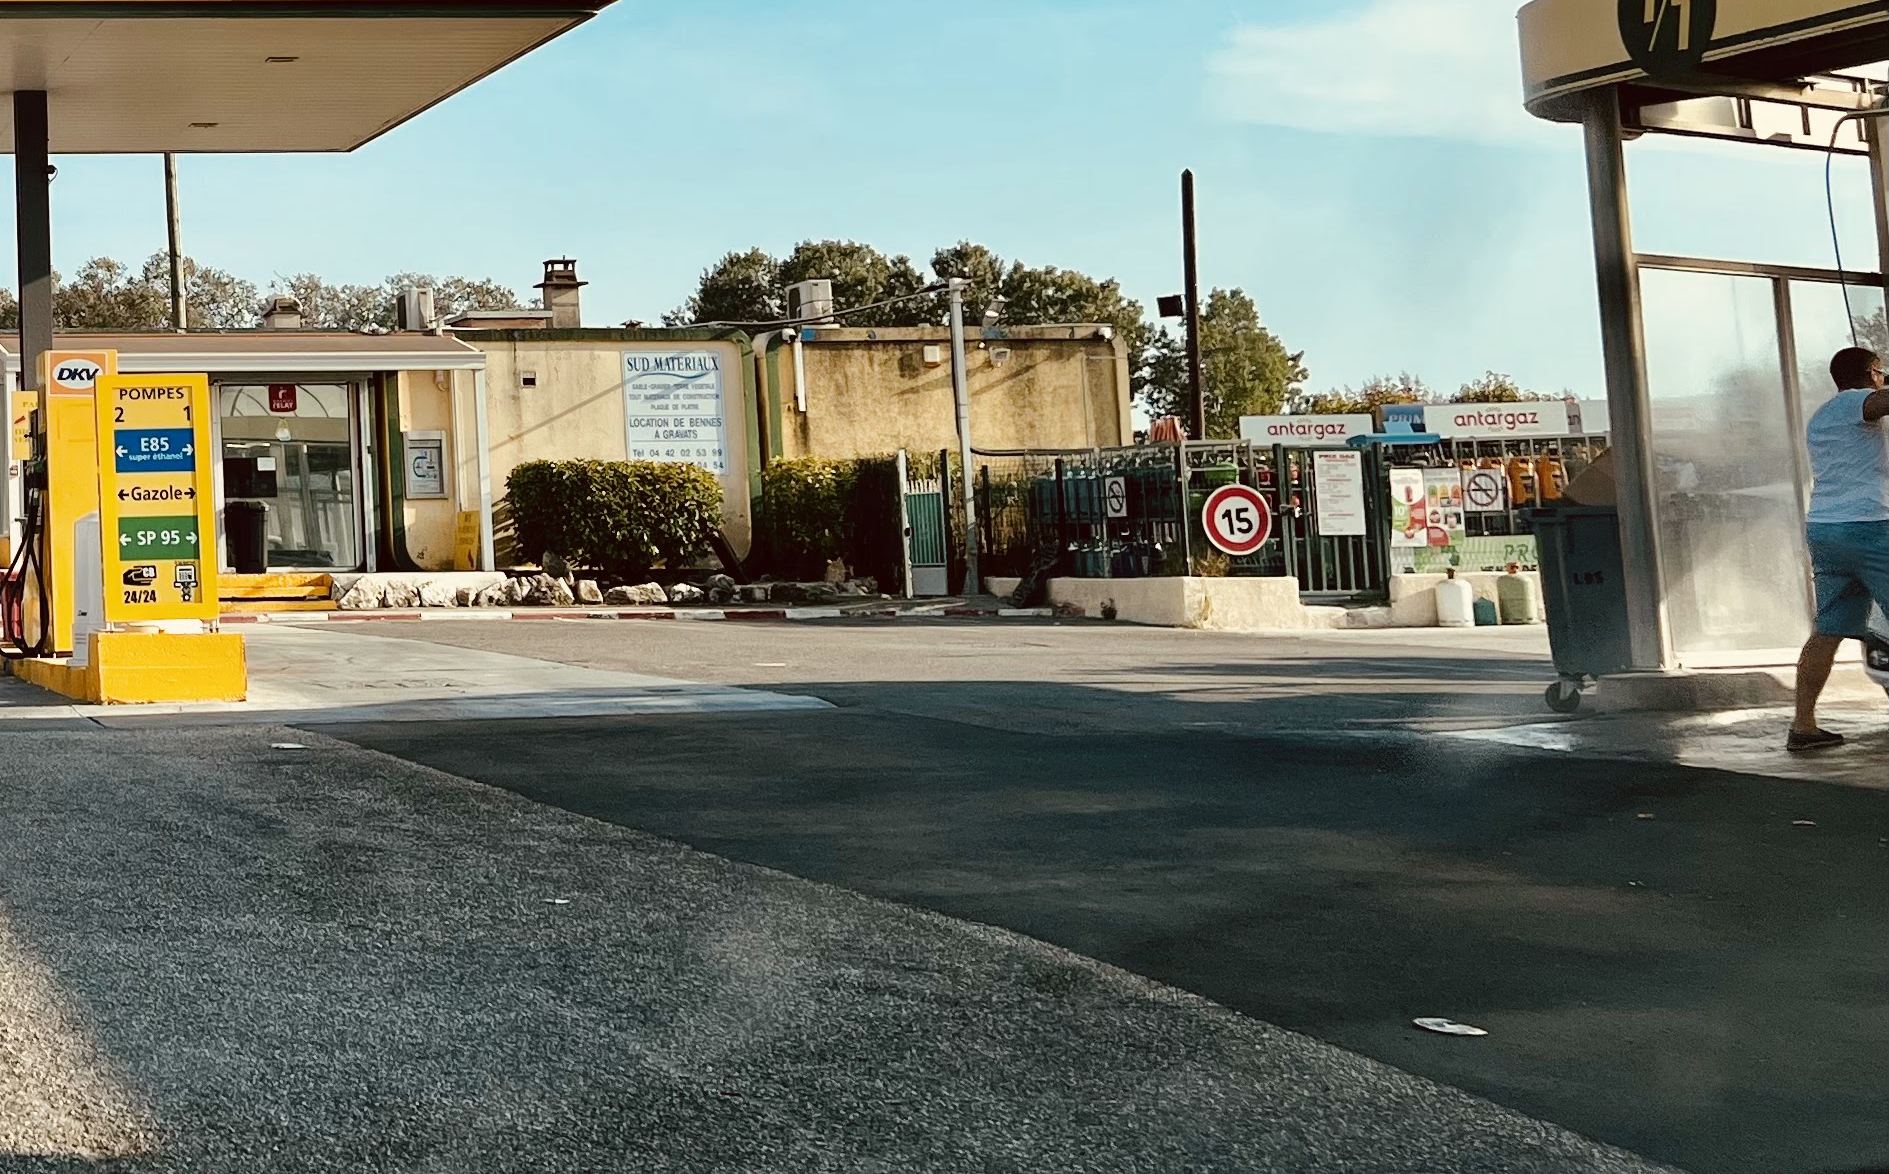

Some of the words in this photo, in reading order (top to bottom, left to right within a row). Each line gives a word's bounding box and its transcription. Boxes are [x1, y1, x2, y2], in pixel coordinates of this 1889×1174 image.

[627, 356, 649, 371] SUD
[654, 356, 719, 371] MATERIAUX
[57, 367, 99, 381] DKV
[119, 387, 184, 400] POMPES
[114, 407, 125, 422] 2
[183, 405, 191, 421] 1
[1454, 410, 1539, 430] antargaz
[629, 418, 669, 427] LOCATION
[673, 418, 685, 427] DE
[689, 417, 722, 427] BENNES
[654, 430, 660, 439] A
[662, 430, 698, 439] GRAVATS
[1268, 422, 1346, 439] antargaz
[140, 437, 170, 452] E85
[129, 453, 151, 462] super
[649, 449, 659, 457] 04
[665, 449, 674, 457] 42
[680, 449, 690, 457] 02
[131, 485, 183, 501] Gazole
[1221, 507, 1253, 535] 15
[137, 530, 157, 546] SP
[161, 530, 180, 545] 95
[124, 590, 157, 604] 24/24
